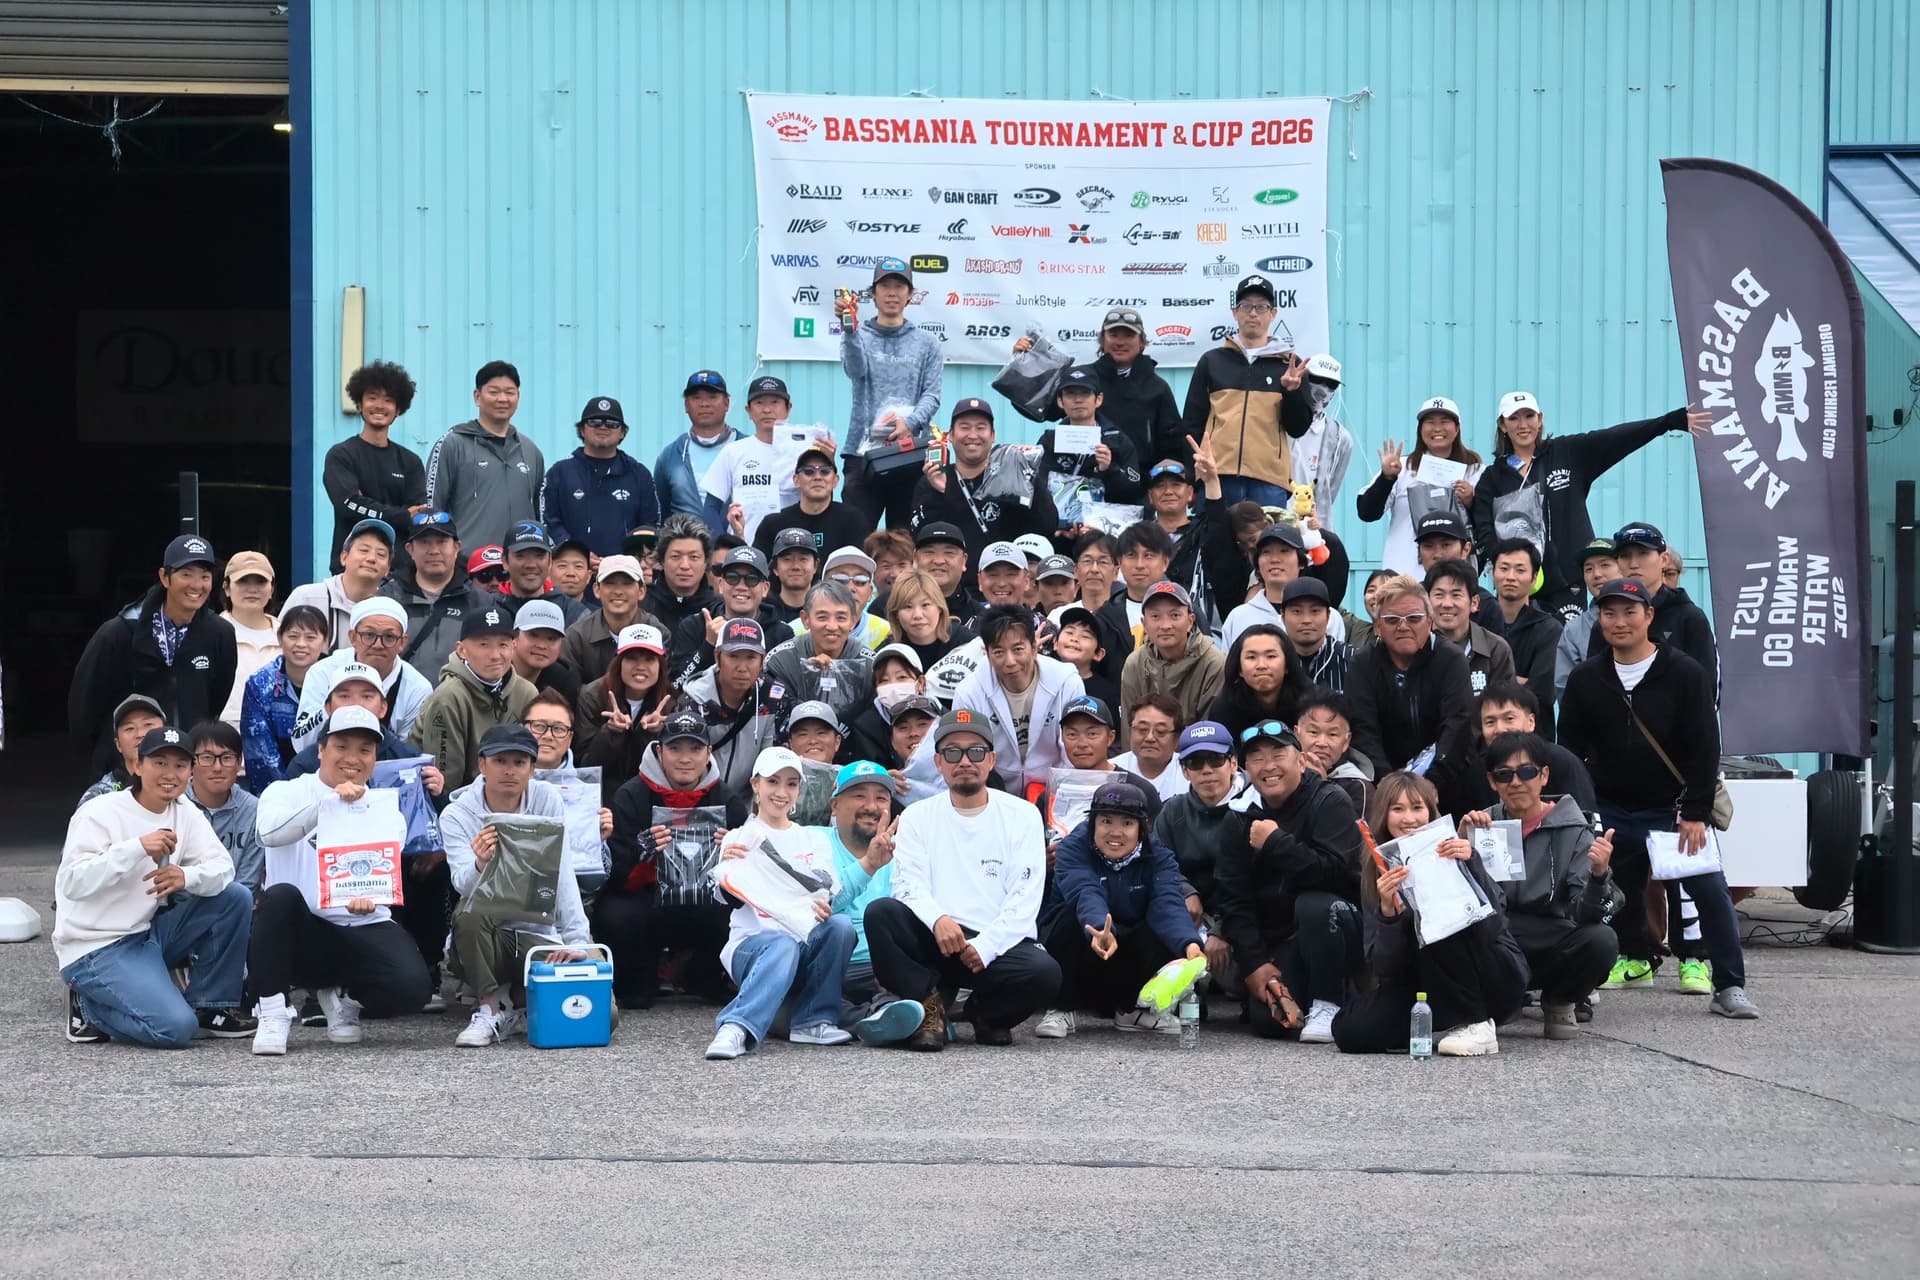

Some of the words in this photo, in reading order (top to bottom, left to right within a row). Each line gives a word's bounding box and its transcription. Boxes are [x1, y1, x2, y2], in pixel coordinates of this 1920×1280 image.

[766, 111, 818, 132] BASSMANIA
[824, 117, 977, 144] BASSMANIA
[985, 121, 1167, 147] TOURNAMENT
[1173, 125, 1188, 145] &
[1192, 122, 1243, 147] CUP
[1251, 119, 1313, 146] 2026
[800, 184, 842, 197] RAID
[862, 188, 913, 198] LUXXE
[944, 192, 964, 204] GAN
[967, 193, 998, 205] CRAFT
[1152, 196, 1188, 204] RYUGI
[857, 223, 922, 233] DSTYLE
[1241, 222, 1300, 236] SMITH
[771, 254, 820, 268] VARIVAS
[913, 259, 945, 269] DUEL
[1050, 264, 1075, 274] RING
[1078, 264, 1106, 274] STAR
[1016, 294, 1066, 308] JunkStyle
[1162, 297, 1215, 308] Basser
[965, 325, 1011, 337] AROS
